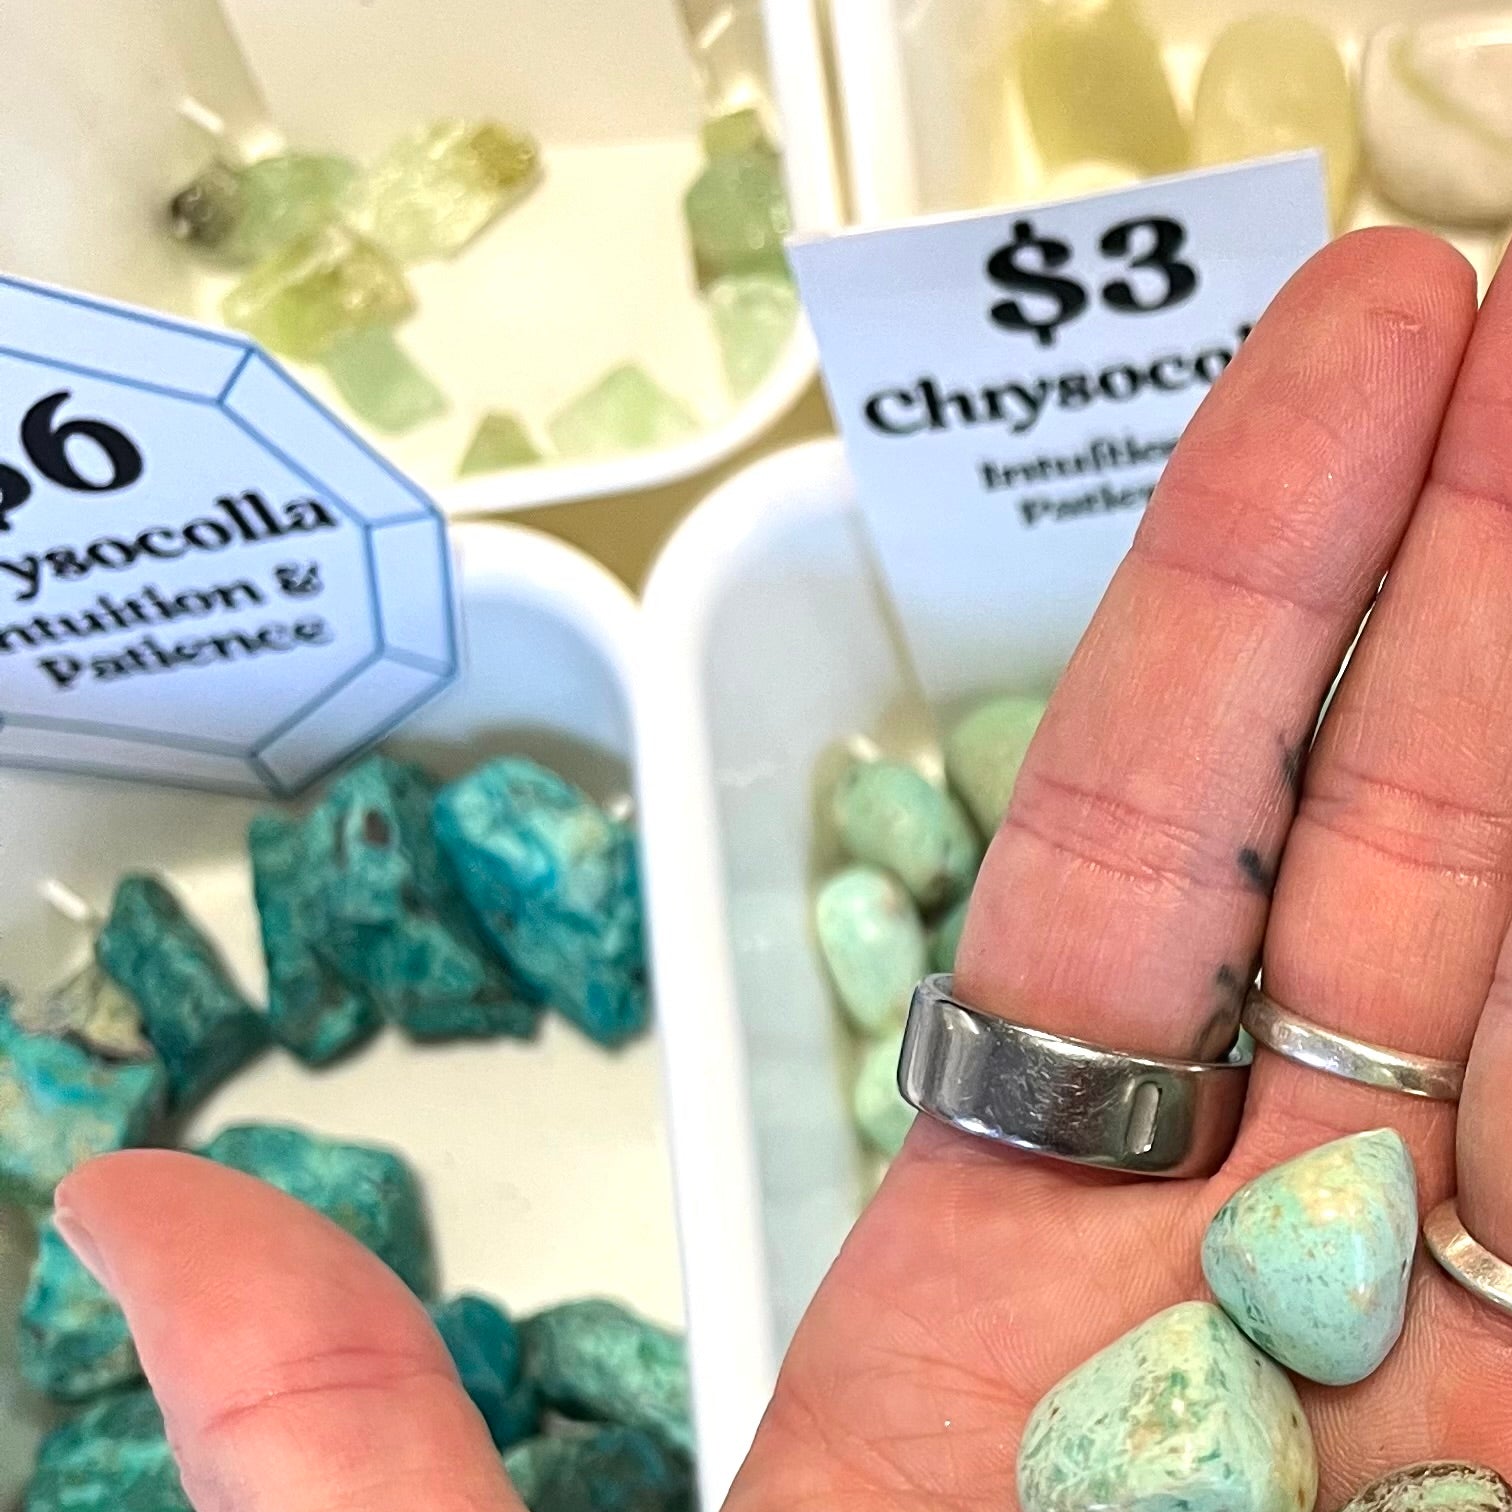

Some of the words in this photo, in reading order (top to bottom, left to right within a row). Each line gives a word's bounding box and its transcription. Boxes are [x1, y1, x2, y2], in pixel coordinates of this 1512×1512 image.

[985, 219, 1199, 348] $3
[864, 322, 1254, 435] Chrysoco
[0, 387, 144, 531] 6
[276, 560, 323, 599] &
[38, 617, 331, 689] Patience
